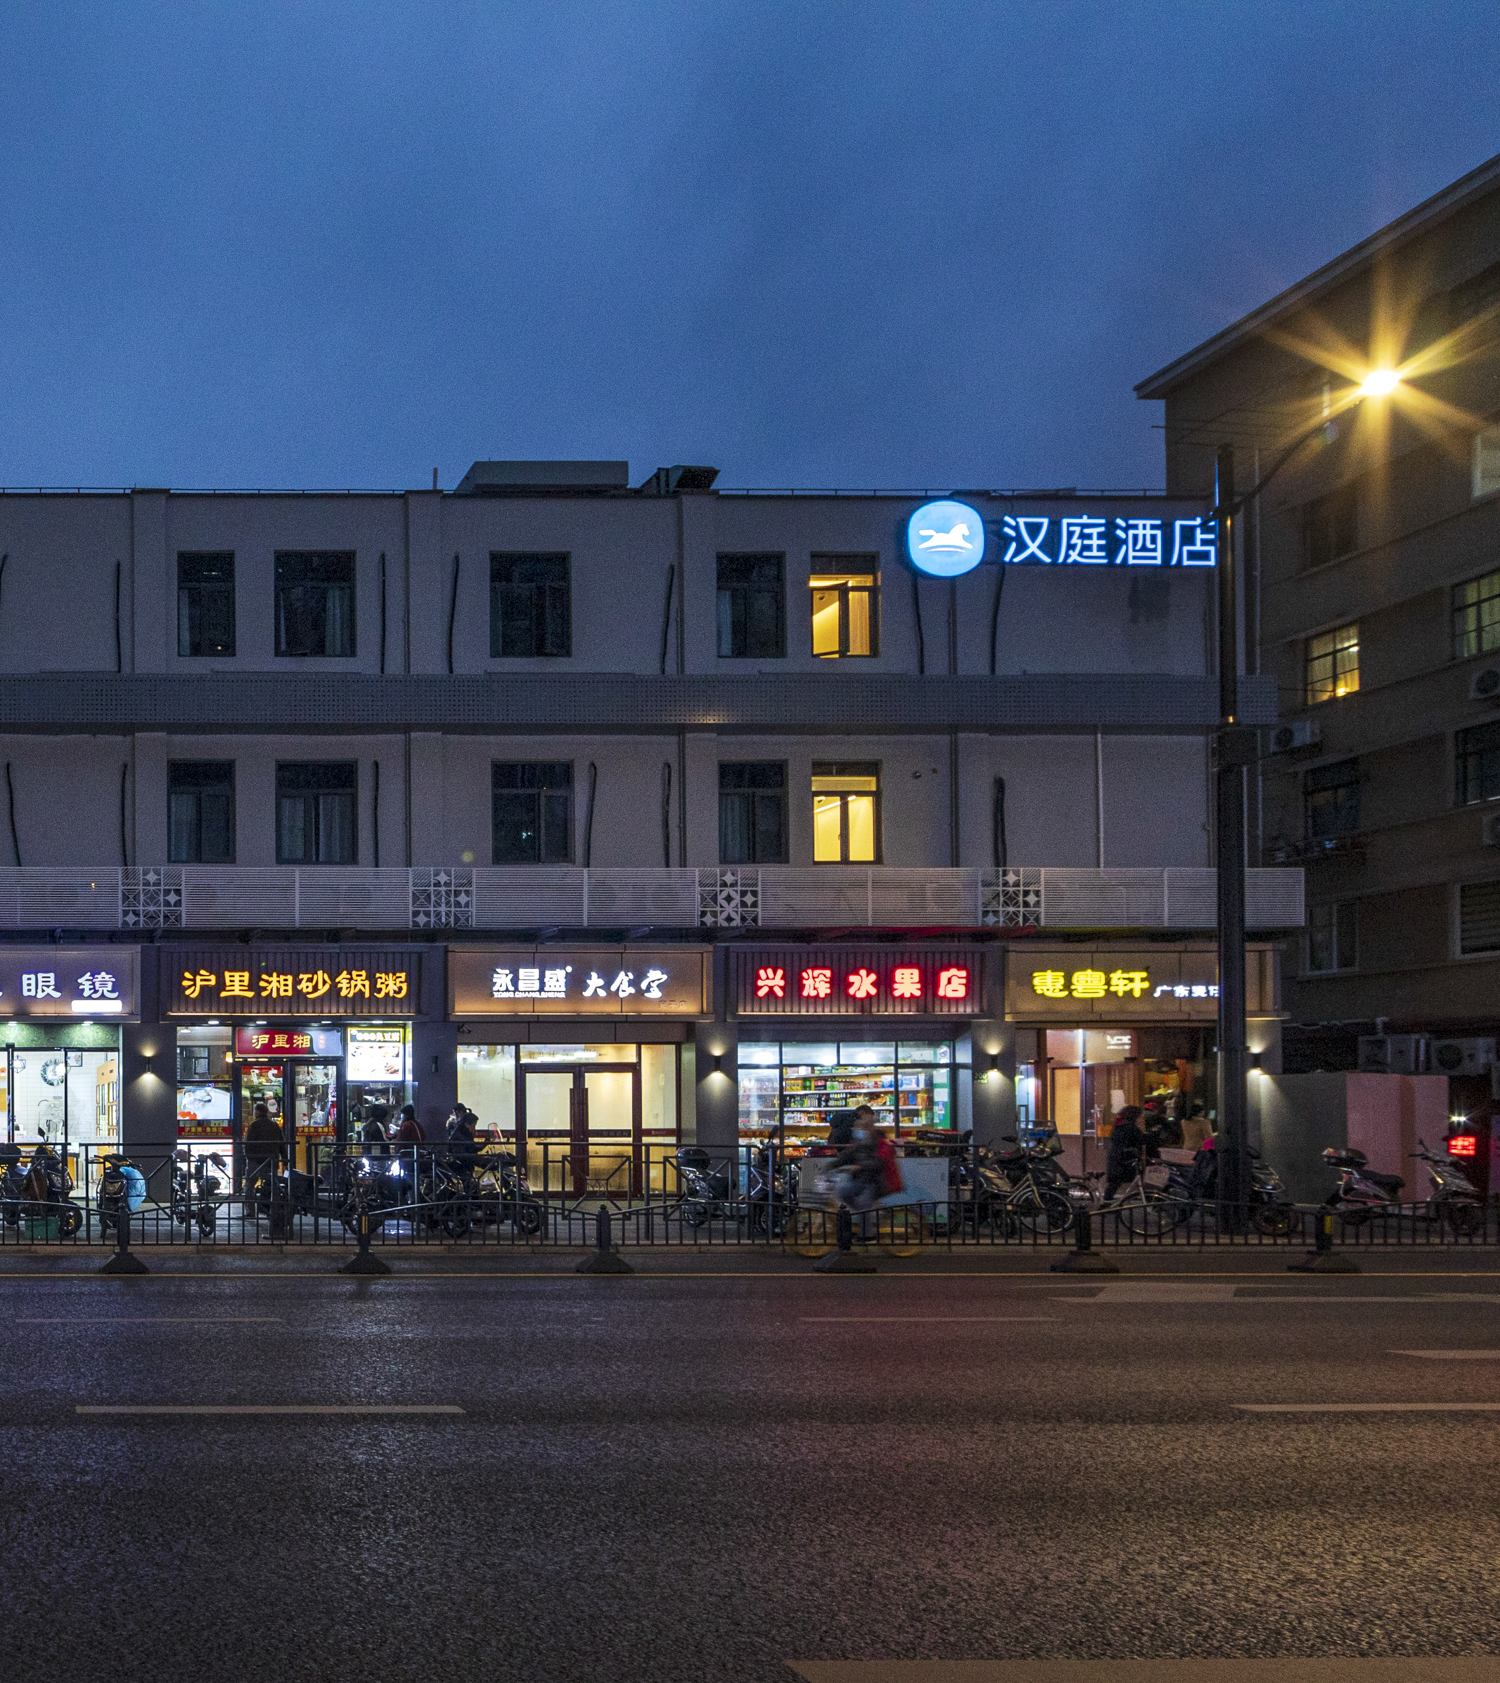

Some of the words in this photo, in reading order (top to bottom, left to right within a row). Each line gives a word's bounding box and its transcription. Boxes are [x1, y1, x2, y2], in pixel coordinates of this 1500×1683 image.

[1002, 515, 1217, 566] 汉庭酒店
[181, 968, 408, 999] 沪里湘砂锅粥
[492, 967, 567, 992] 永昌盛
[756, 967, 969, 999] 兴辉水果店
[1032, 969, 1150, 998] 惠粤轩
[251, 1034, 311, 1049] 沪里湘
